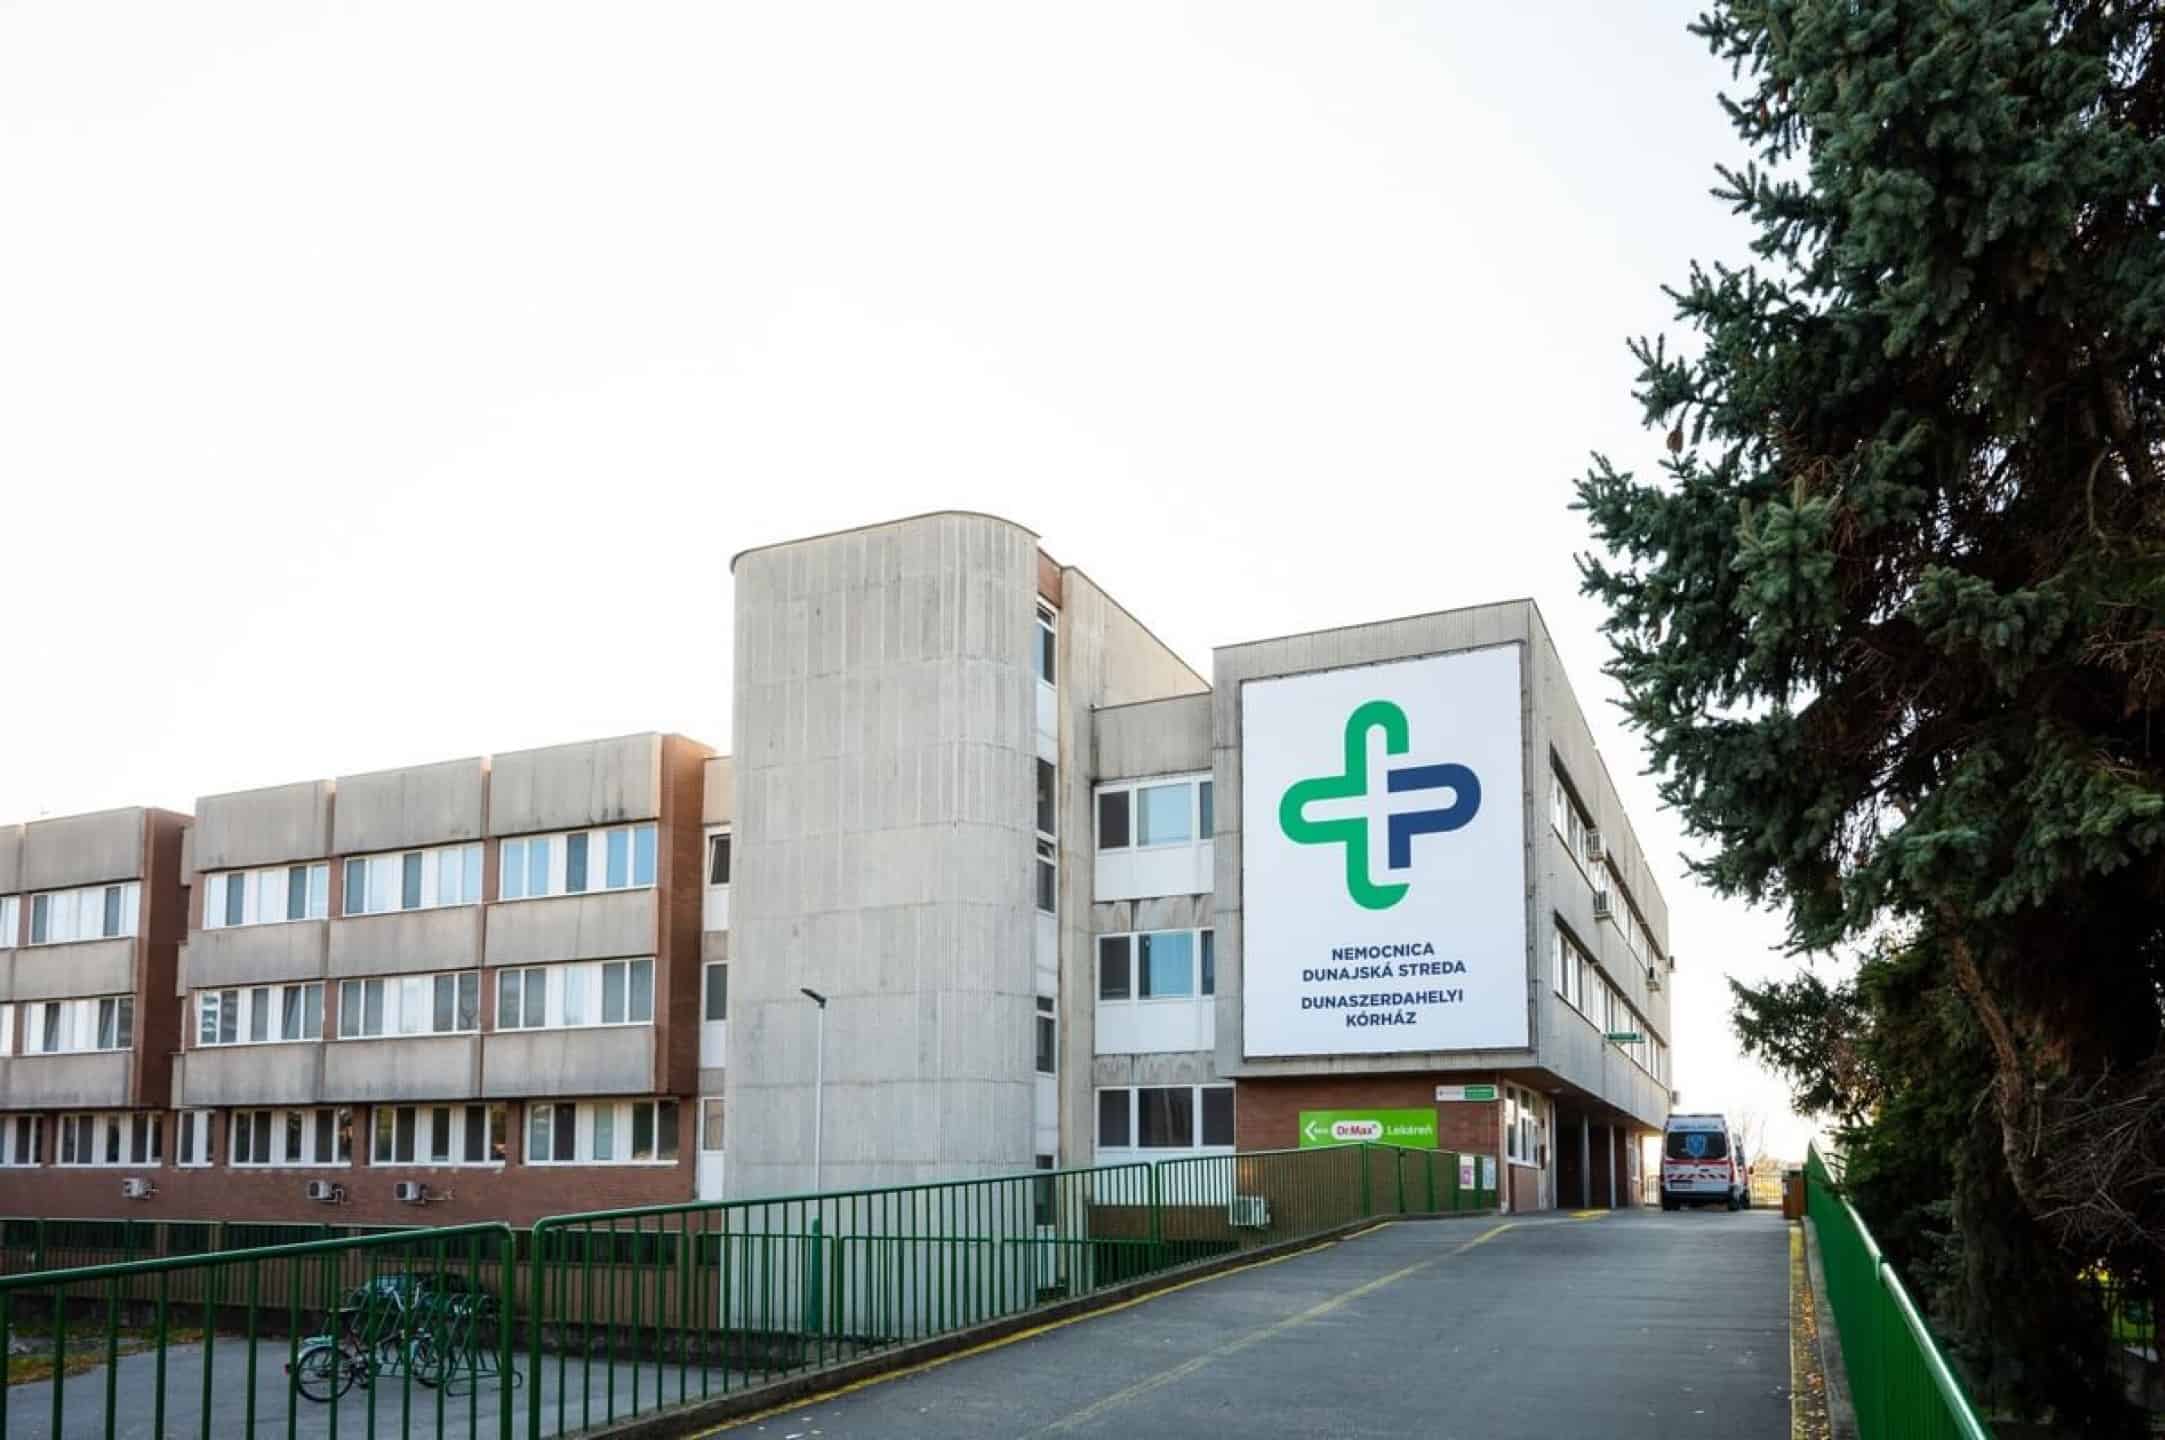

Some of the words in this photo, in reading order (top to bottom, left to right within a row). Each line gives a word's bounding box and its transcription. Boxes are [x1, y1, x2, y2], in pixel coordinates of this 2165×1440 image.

[1331, 942, 1435, 961] NEMOCNICA
[1302, 961, 1394, 982] DUNAJSKÁ
[1398, 960, 1467, 977] STREDA
[1301, 988, 1464, 1010] DUNASZERDAHELYI
[1345, 1009, 1417, 1028] KÓRHÁZ
